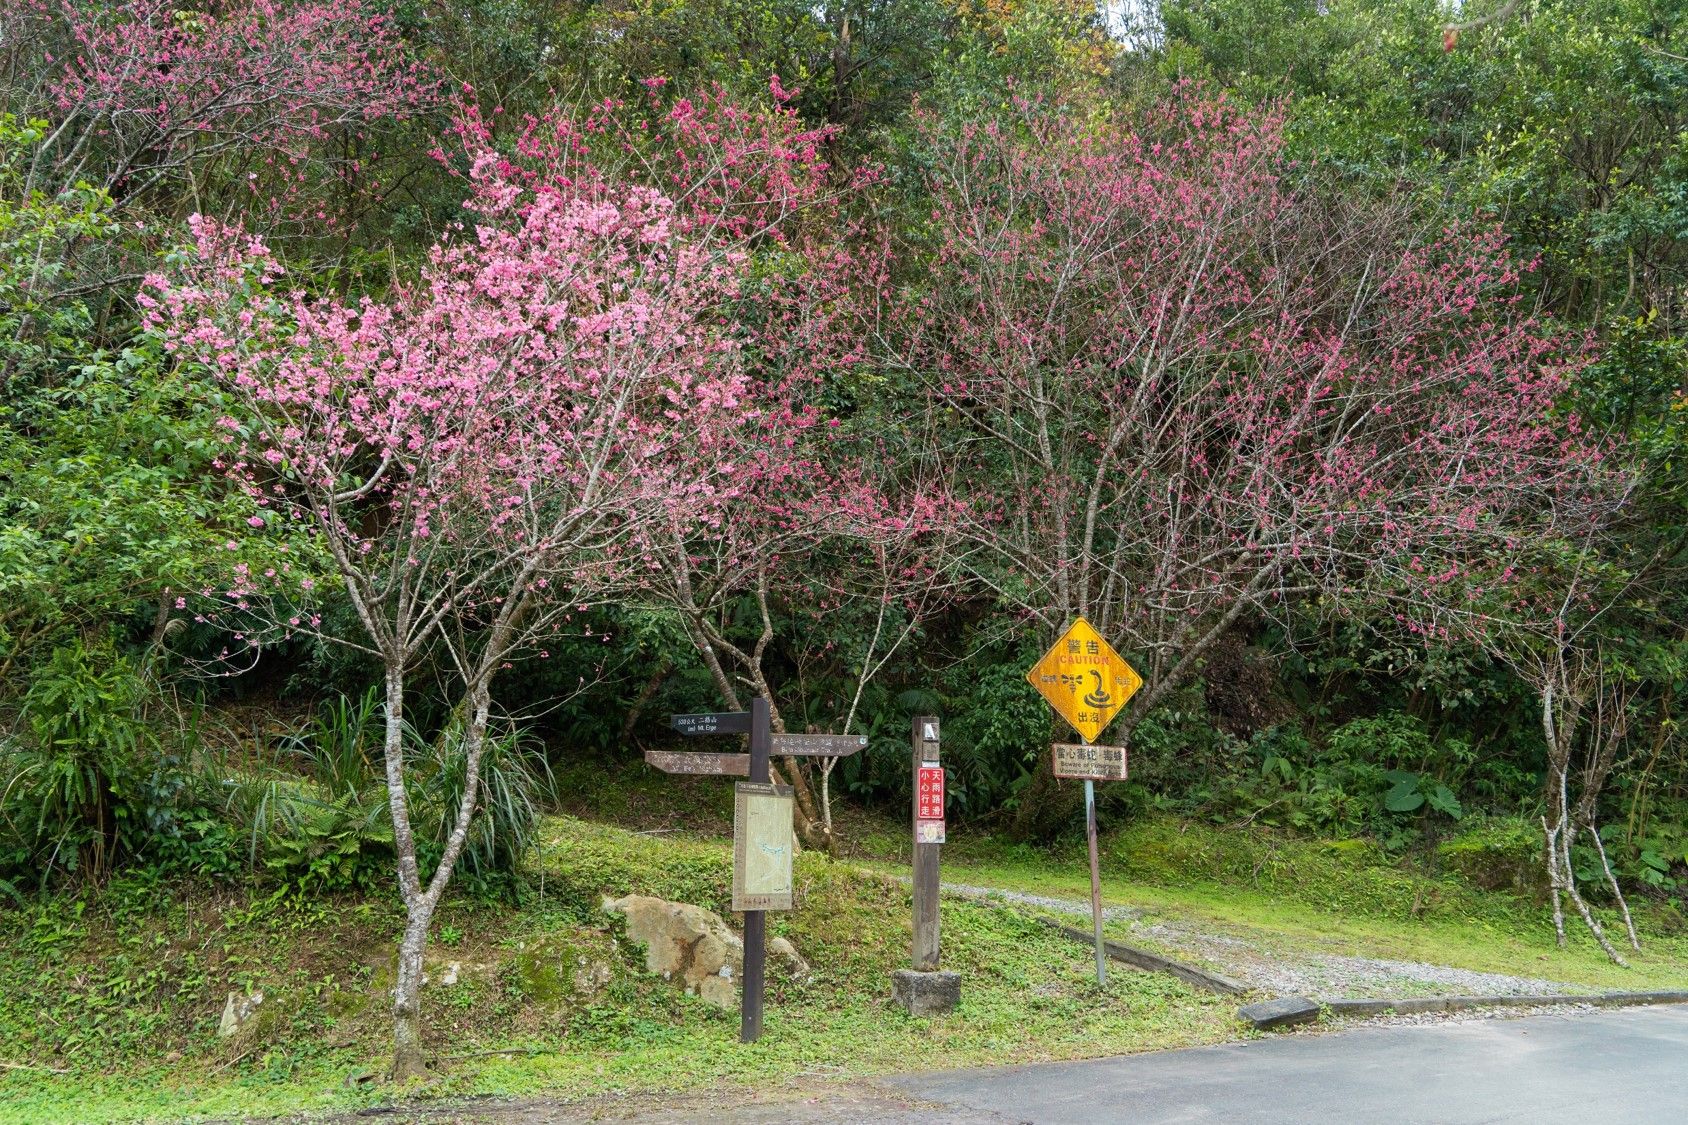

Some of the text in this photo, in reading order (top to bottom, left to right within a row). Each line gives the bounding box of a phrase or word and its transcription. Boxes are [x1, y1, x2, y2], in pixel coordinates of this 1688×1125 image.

[1068, 639, 1099, 654] 警告
[1060, 655, 1110, 665] CAUTION
[1078, 712, 1100, 723] 出沒
[921, 771, 930, 816] 小心行走
[931, 771, 941, 816] 天雨路滑
